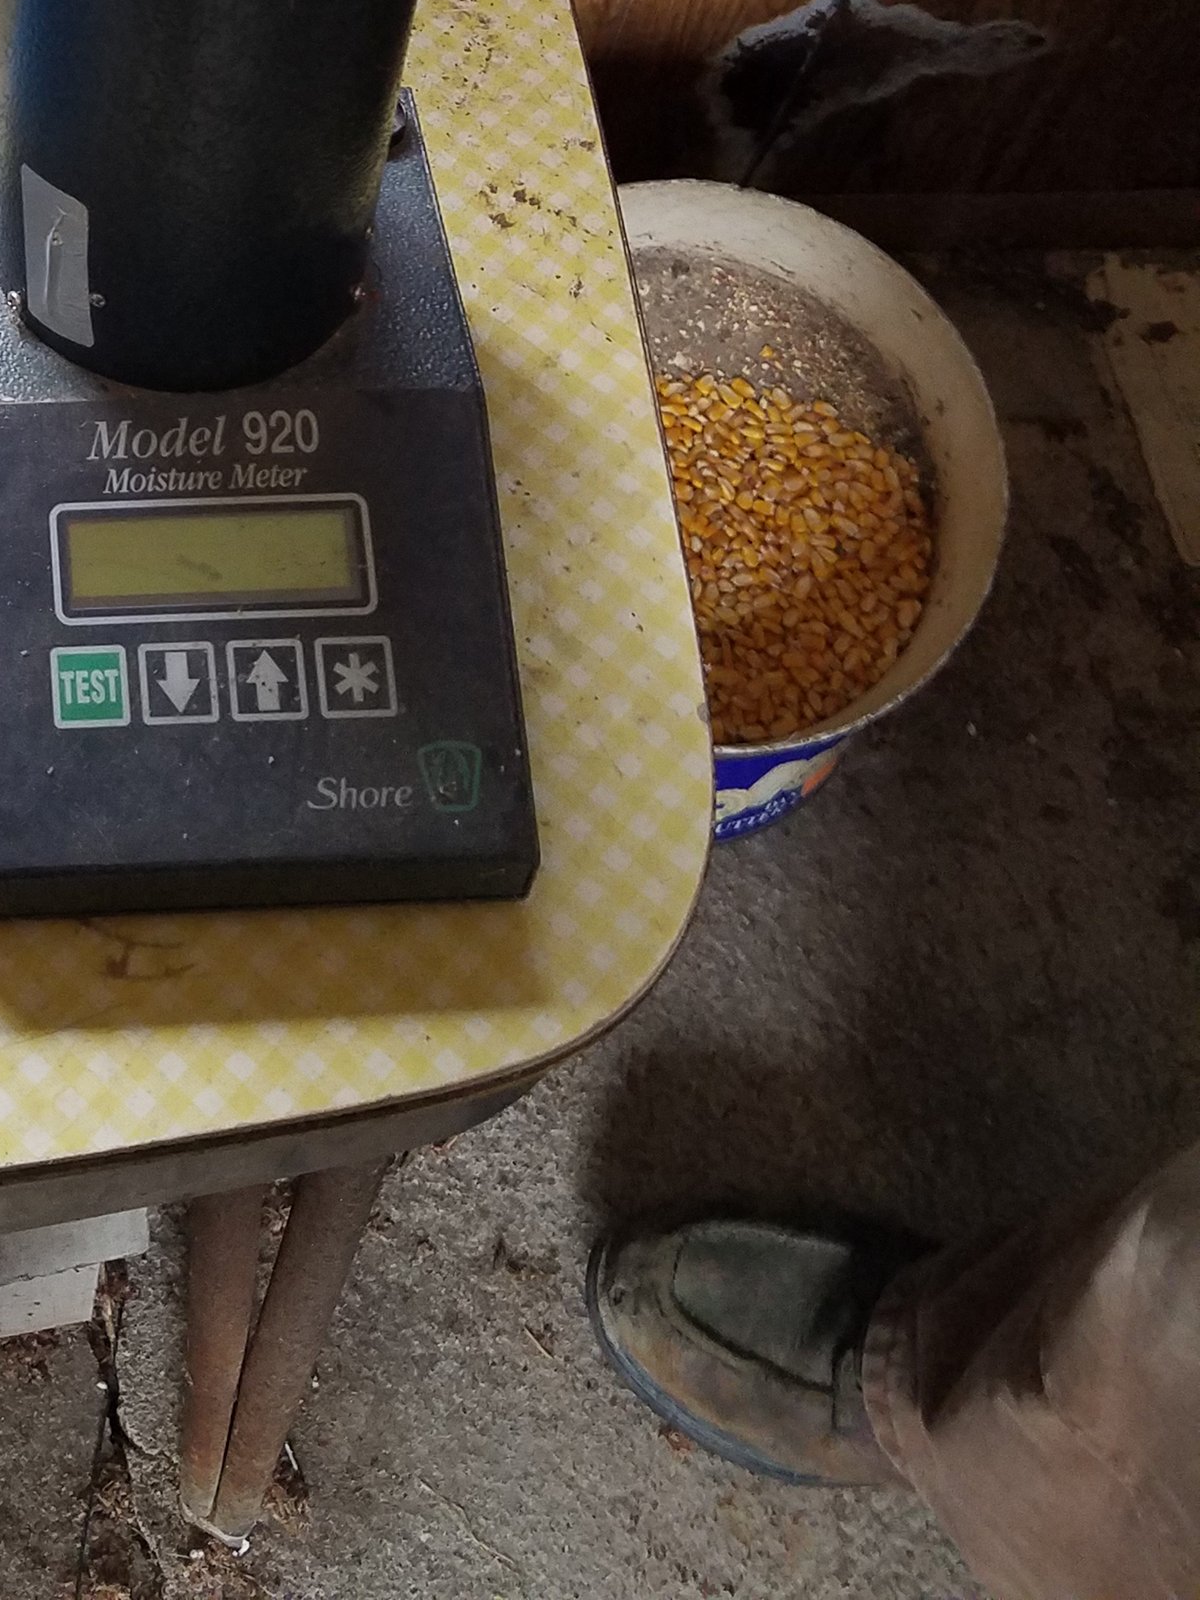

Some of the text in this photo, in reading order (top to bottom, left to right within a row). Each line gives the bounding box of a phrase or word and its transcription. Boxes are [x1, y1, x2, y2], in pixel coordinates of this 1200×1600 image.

[86, 409, 320, 461] Model 920
[103, 462, 308, 494] Moisture Meter
[60, 669, 119, 704] TEST
[307, 776, 413, 810] Shore
